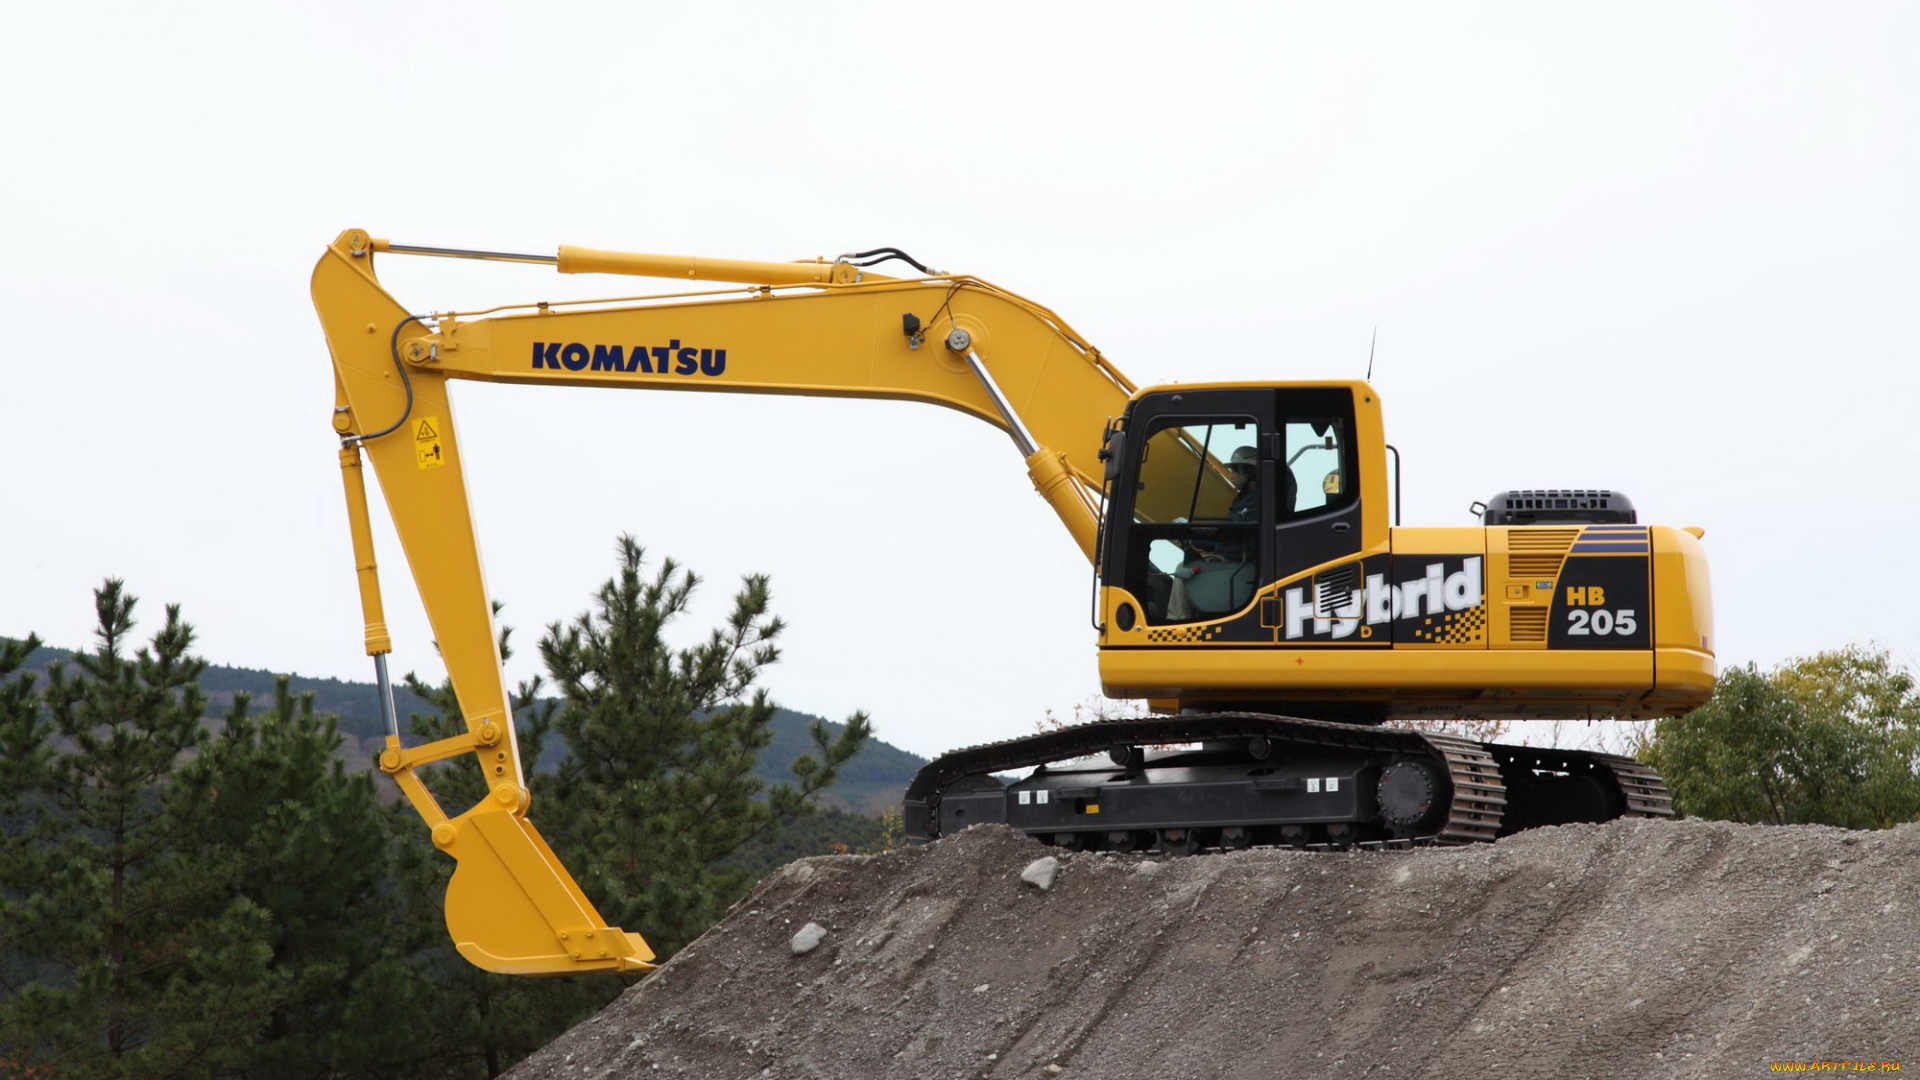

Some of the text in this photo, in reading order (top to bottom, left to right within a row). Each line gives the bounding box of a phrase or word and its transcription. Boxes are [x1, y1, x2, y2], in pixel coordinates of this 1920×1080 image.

[532, 339, 726, 376] KOMATSU
[1285, 556, 1482, 640] Hybrid
[1566, 586, 1606, 606] HB
[1567, 609, 1637, 636] 205
